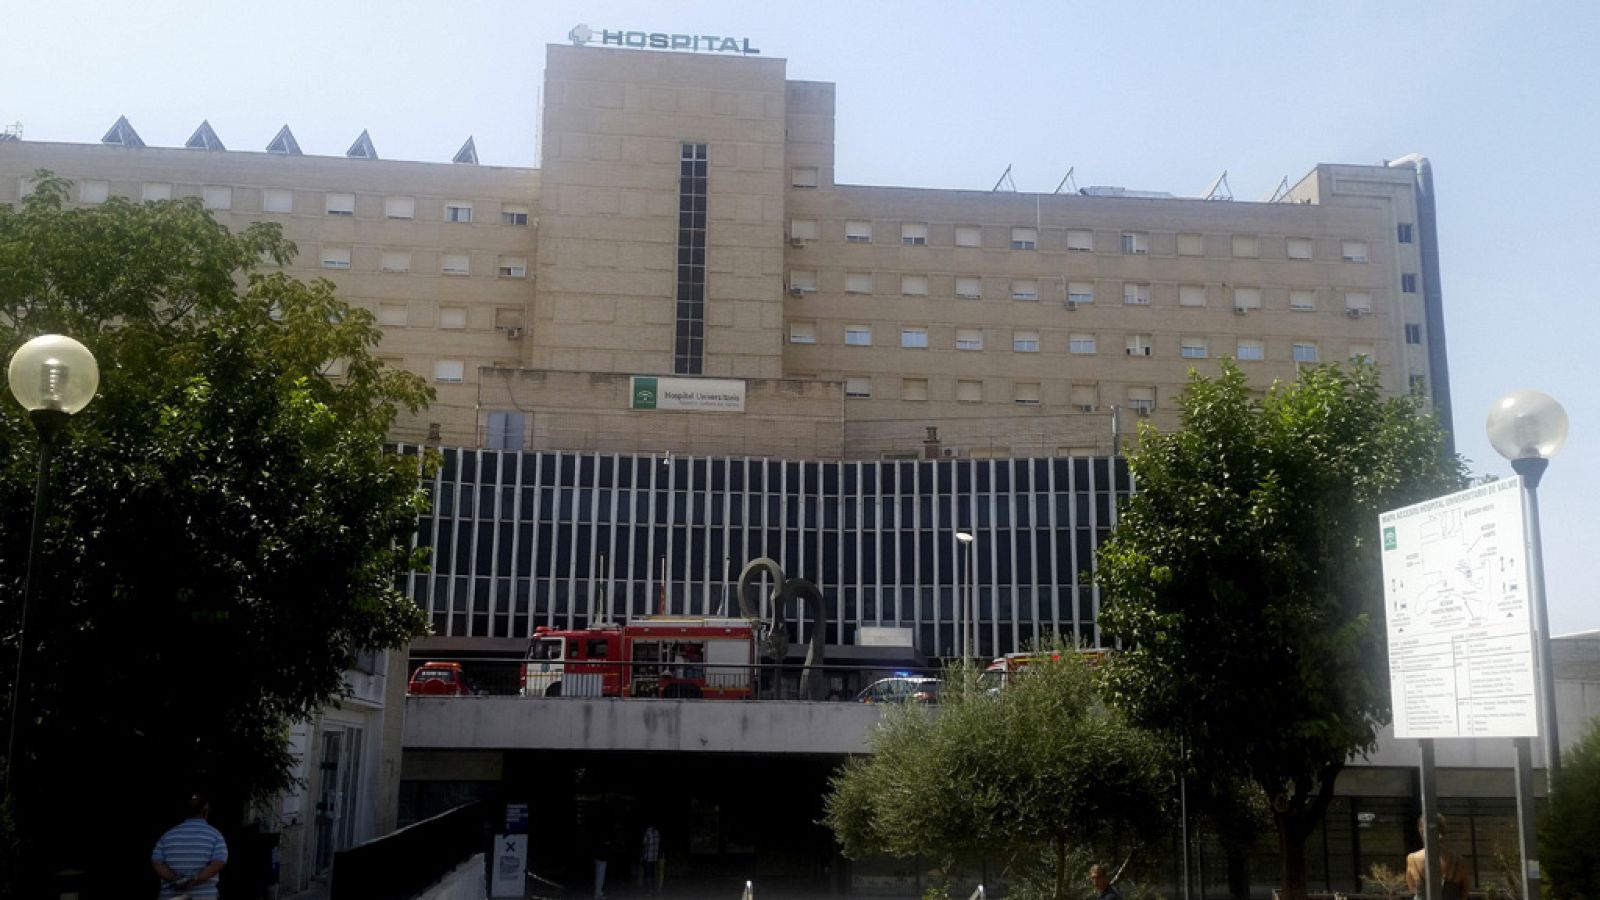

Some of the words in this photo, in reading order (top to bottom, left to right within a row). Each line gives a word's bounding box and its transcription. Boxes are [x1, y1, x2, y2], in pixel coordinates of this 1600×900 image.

[602, 29, 760, 53] HOSPITAL
[664, 392, 694, 400] Hospital
[1420, 500, 1445, 513] HOSPITAL
